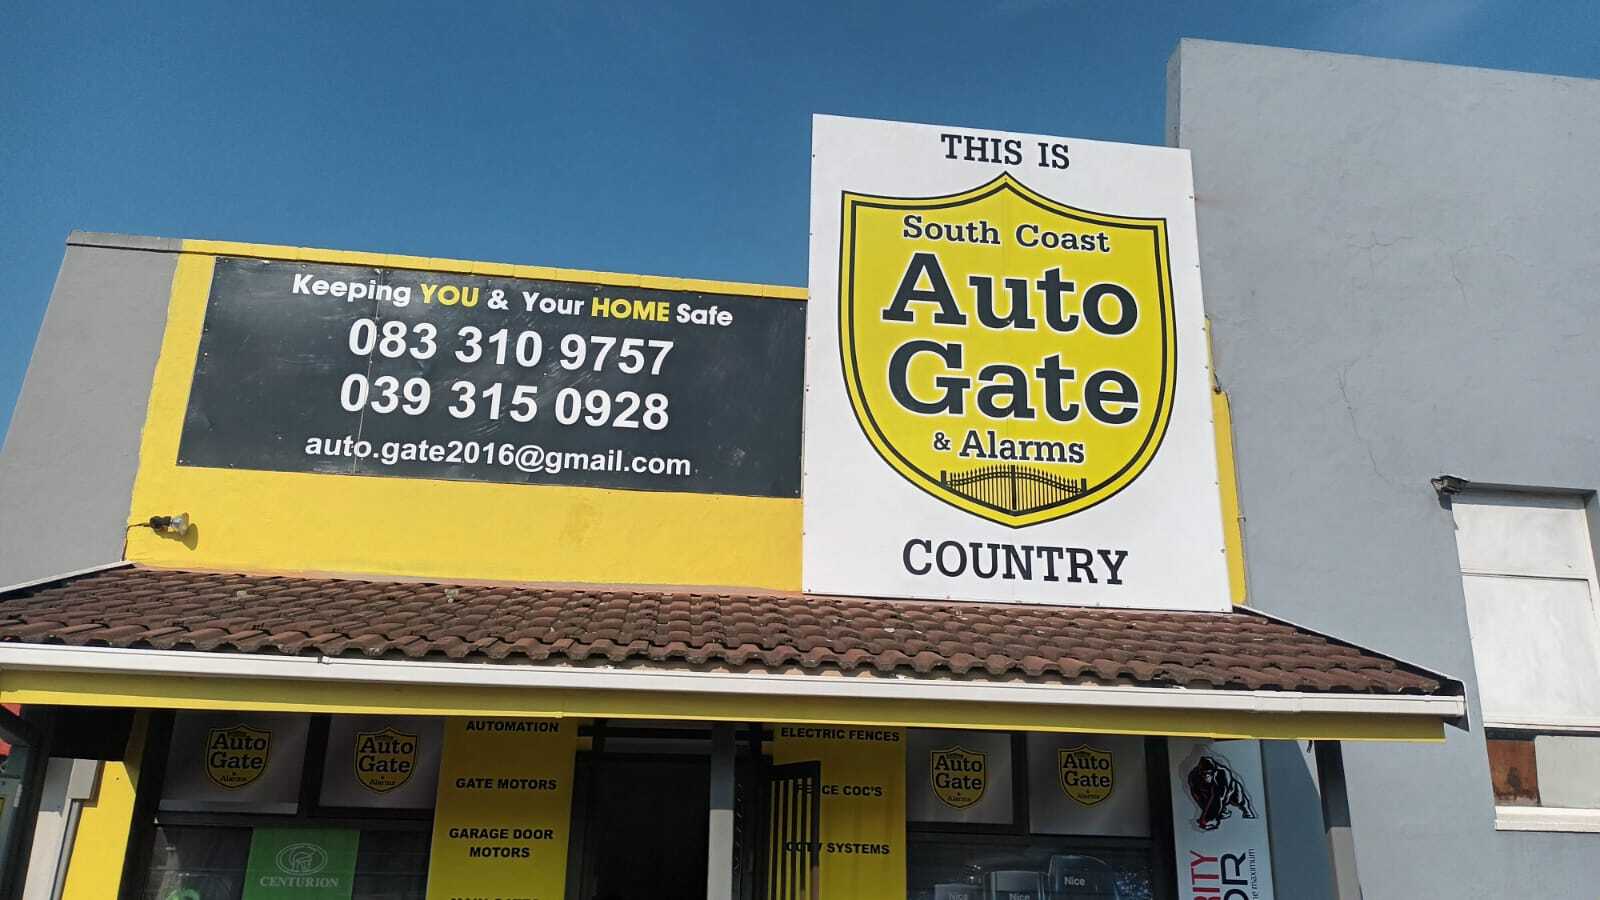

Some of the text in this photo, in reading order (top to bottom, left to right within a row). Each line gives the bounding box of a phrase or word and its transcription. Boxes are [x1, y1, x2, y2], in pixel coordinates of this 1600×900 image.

[941, 133, 1070, 170] THIS IS
[902, 214, 1111, 253] South Coast
[292, 273, 734, 327] Keeping YOU & Your HOME Safe
[882, 252, 1138, 336] Auto
[348, 317, 675, 377] 083 310 9757
[887, 339, 1139, 425] Gate
[340, 372, 670, 431] 039 315 0928
[933, 429, 1085, 464] & Alarms
[305, 435, 691, 476] auto.gate2016@gmail.com
[903, 538, 1129, 586] COUNTRY
[466, 721, 560, 733] AUTOMATION
[781, 727, 900, 742] ELECTRIC FENCES
[212, 733, 267, 750] Auto
[359, 737, 414, 755] Auto
[210, 752, 264, 769] Gate
[358, 756, 411, 773] Gate
[934, 755, 983, 772] Auto
[1063, 753, 1110, 770] Auto
[456, 778, 557, 791] GATE MOTORS
[935, 773, 983, 790] Gate
[1064, 771, 1111, 788] Gate
[797, 785, 883, 797] FECE COC'S
[449, 828, 553, 840] GARAGE DOOR
[470, 846, 530, 858] MOTORS
[827, 843, 890, 854] SYSTEMS
[259, 875, 339, 888] CENTURION
[1064, 876, 1086, 887] Nice
